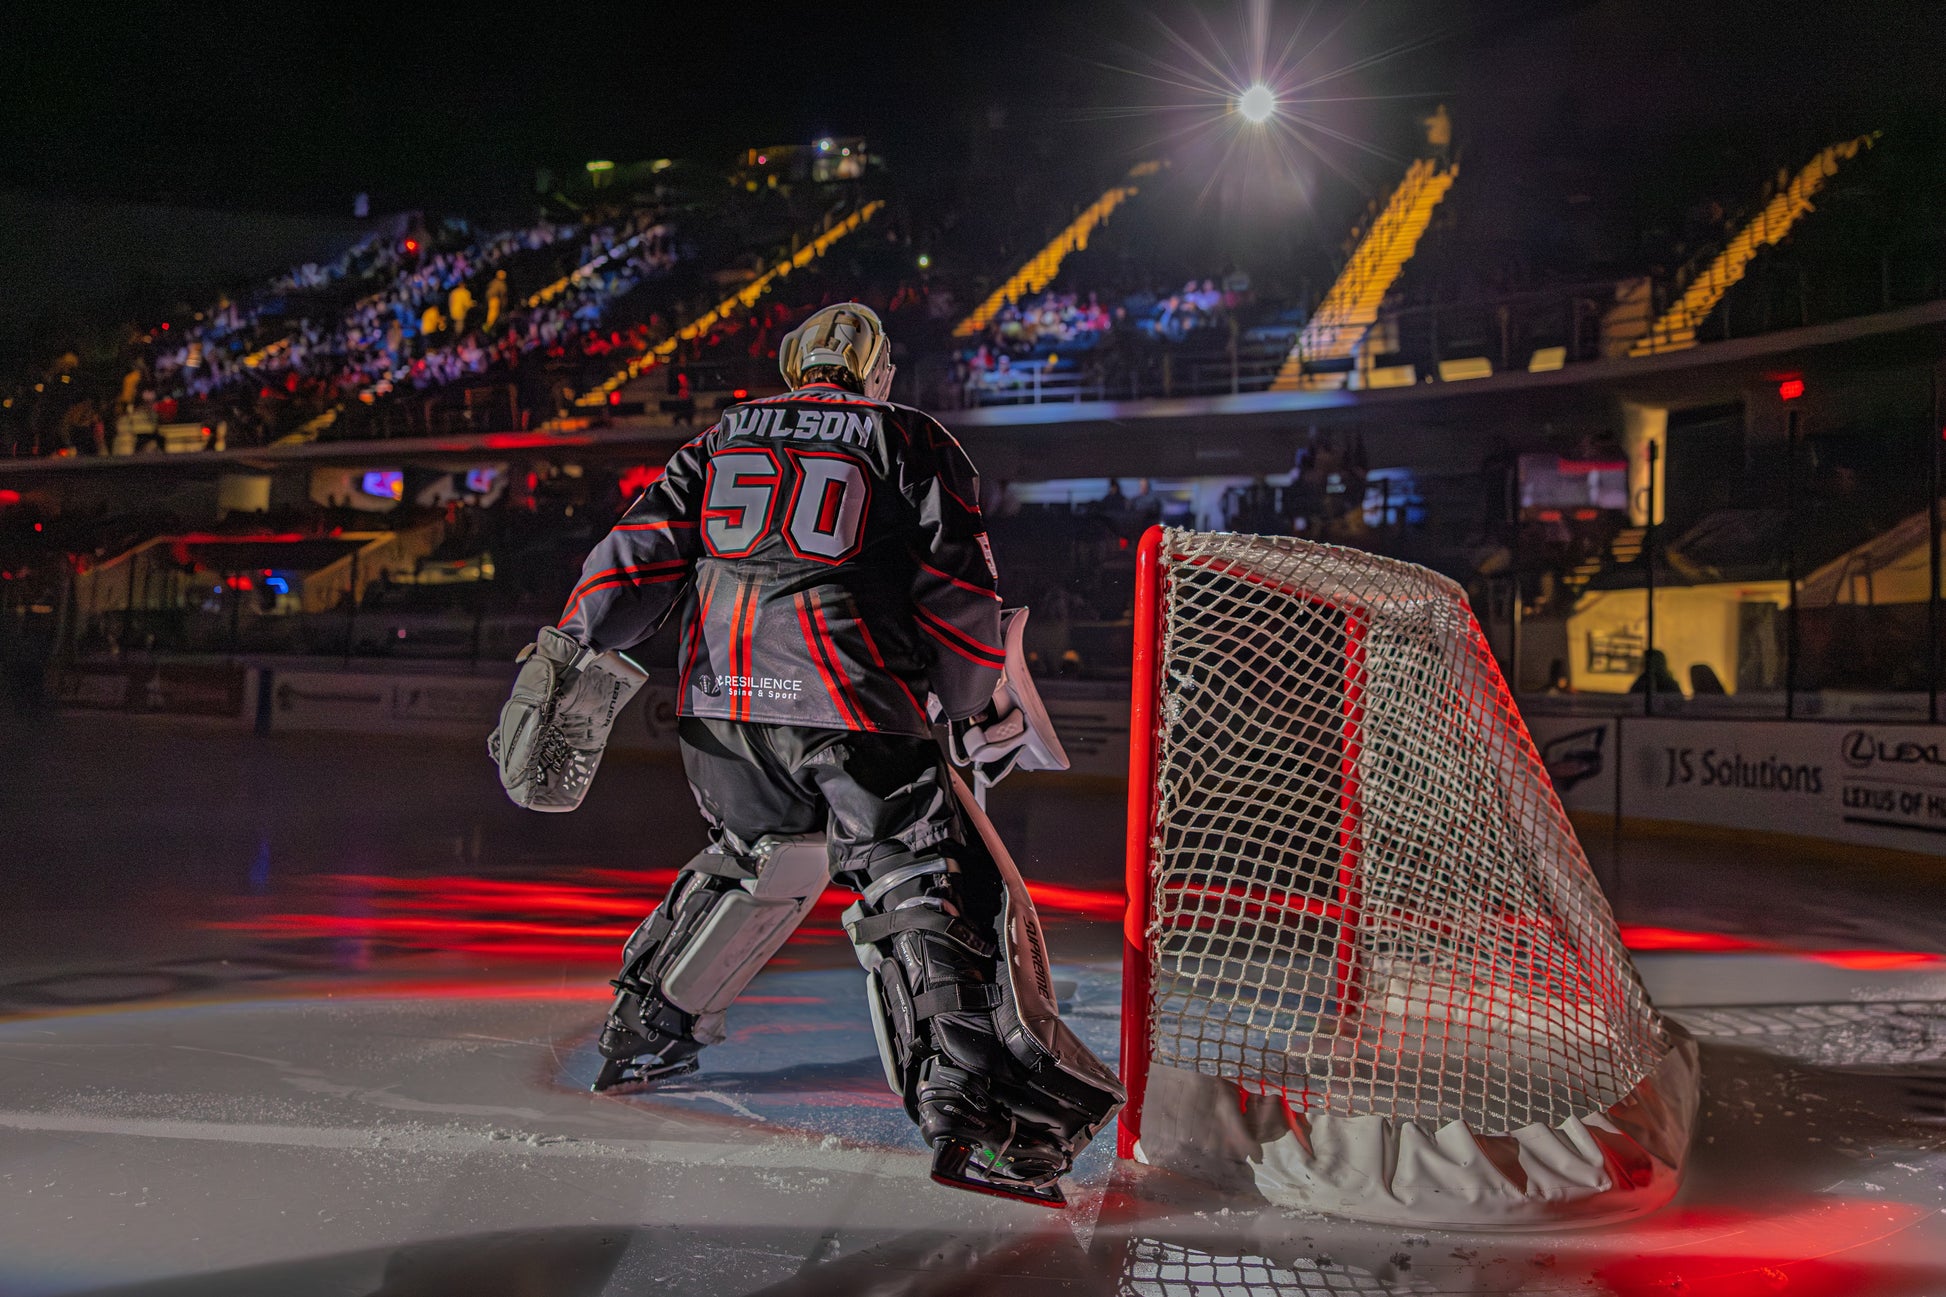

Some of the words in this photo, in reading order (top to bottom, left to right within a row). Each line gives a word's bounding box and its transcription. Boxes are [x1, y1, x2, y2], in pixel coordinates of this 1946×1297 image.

[725, 408, 873, 448] WILSON
[701, 448, 872, 566] 50
[724, 675, 802, 691] RESILIENCE
[729, 687, 752, 697] Spine
[758, 689, 764, 697] &
[768, 690, 797, 699] Sport
[1665, 749, 1694, 787] JS
[1700, 750, 1823, 794] Solutions
